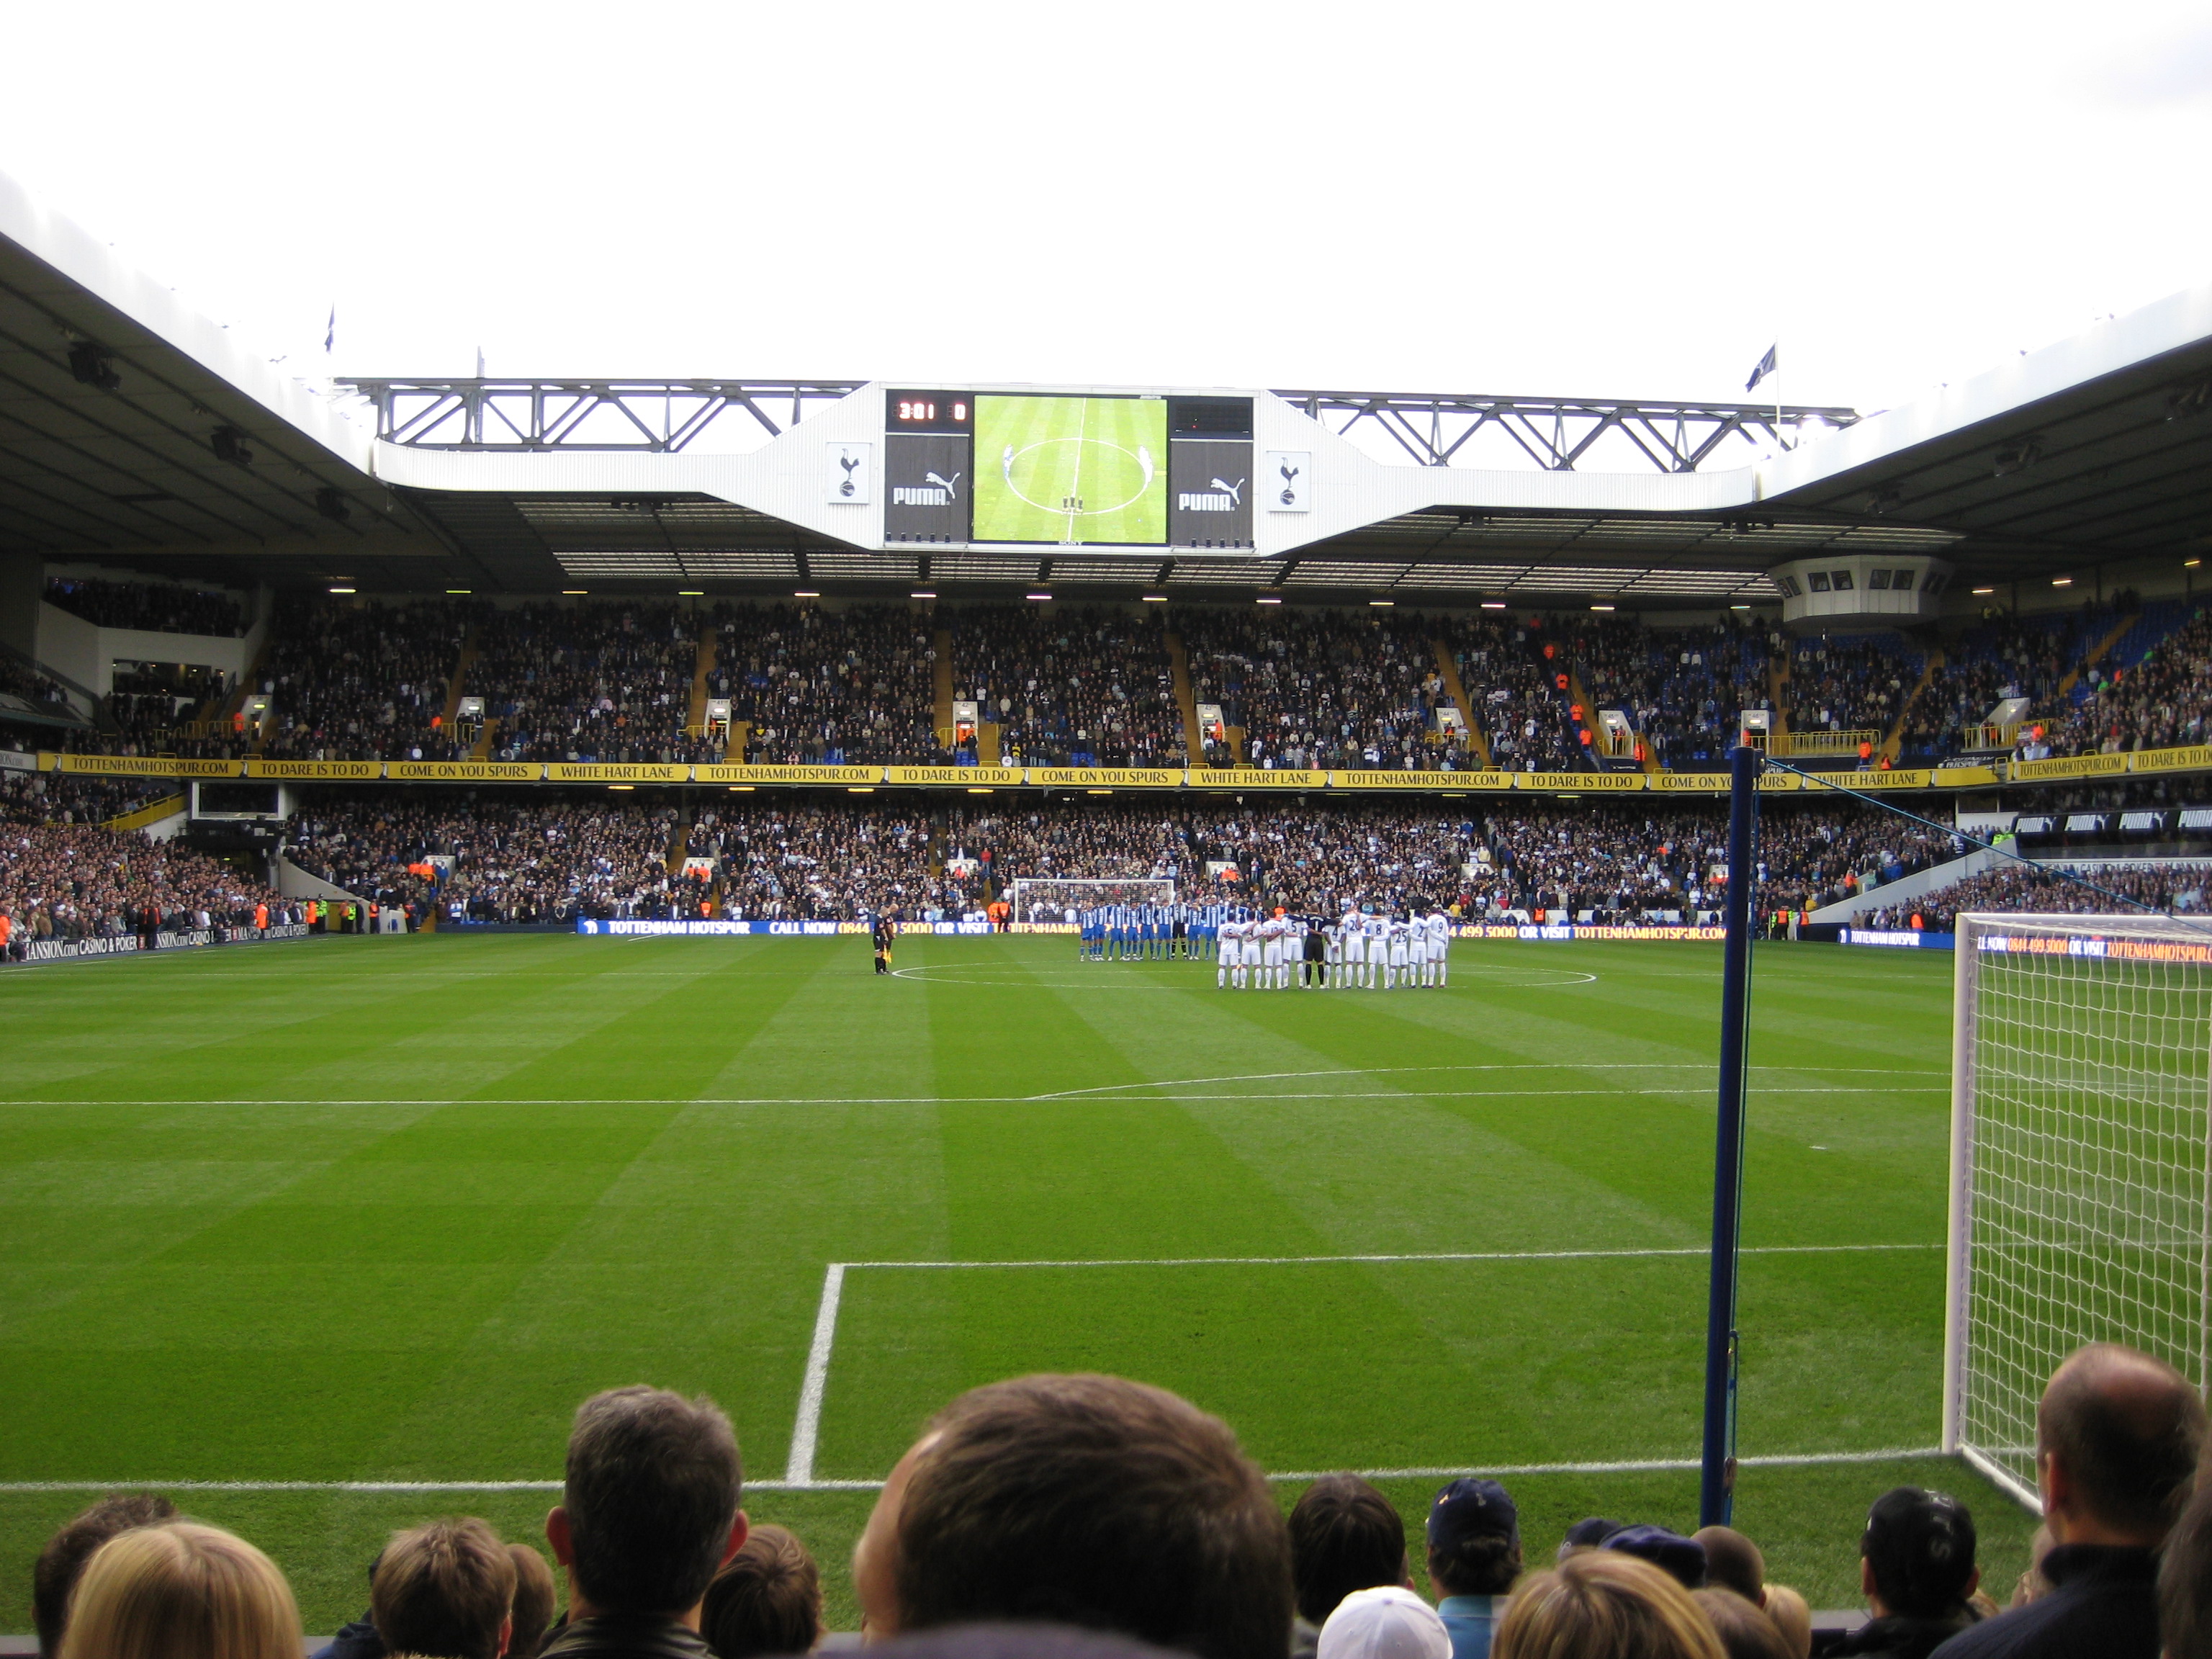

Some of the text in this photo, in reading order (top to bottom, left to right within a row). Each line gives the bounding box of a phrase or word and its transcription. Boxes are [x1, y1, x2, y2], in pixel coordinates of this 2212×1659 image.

[899, 403, 934, 420] 3:01
[894, 487, 946, 505] PUMA
[1179, 493, 1231, 511] PUMA
[73, 757, 228, 774] TOTTENHAMHOTSPUR.COM
[2138, 755, 2149, 768] TO
[2152, 753, 2175, 767] DARE
[2178, 752, 2186, 764] IS
[2189, 751, 2201, 764] TO
[261, 763, 369, 776] TO DARE IS TO DO
[400, 765, 528, 778] COME ON YOU SPURS
[562, 766, 674, 778] WHITE HART LANE
[709, 767, 869, 780] TOTTENHAMHOTSPUR.COM
[2020, 757, 2121, 777] TOTTENHAMHOTSPUR.COM
[902, 769, 1010, 782] TO DARE IS TO DO
[1041, 770, 1169, 783] COME ON YOU SPURS
[1201, 772, 1311, 784] WHITE HART LANE
[1346, 773, 1499, 786] TOTTENHAMHOTSPUR.COM
[1530, 775, 1632, 788] TO DARE IS TO DO
[1662, 775, 1787, 788] COME ON YO PURS
[1818, 773, 1917, 786] WHITE HART LANE
[2015, 817, 2045, 833] PUMA
[2064, 814, 2096, 831] PUMA
[2118, 812, 2153, 830] PUMA
[608, 921, 751, 935] TOTTENHAM HOTSPUR
[769, 922, 801, 934] CALL
[804, 922, 836, 934] NOW
[837, 922, 870, 934] 0844
[900, 922, 933, 935] 5000
[935, 922, 955, 934] OR
[957, 922, 989, 934] VISIT
[1291, 921, 1297, 932] 5
[1315, 921, 1318, 932] 1
[1332, 926, 1338, 938] 4
[1375, 924, 1382, 935] 8
[1438, 922, 1444, 933] 9
[1460, 926, 1483, 938] 499
[1485, 926, 1517, 938] 5000
[1519, 927, 1537, 939] OR
[1540, 927, 1571, 939] VISIT
[1573, 927, 1727, 940] TOTTENHAMHOTSPUR.COM
[189, 930, 210, 946] CASINO
[1395, 930, 1407, 943] 25
[1851, 930, 1920, 946] TOTTENHAM HOTSPUR
[79, 938, 107, 955] CASINO
[109, 938, 114, 952] &
[115, 935, 138, 951] POKER
[1987, 937, 2008, 951] NOW
[2008, 938, 2027, 952] 0844
[2028, 938, 2045, 953] 499
[2046, 939, 2068, 953] 5000
[2069, 940, 2082, 955] OR
[2083, 940, 2105, 956] VISIT
